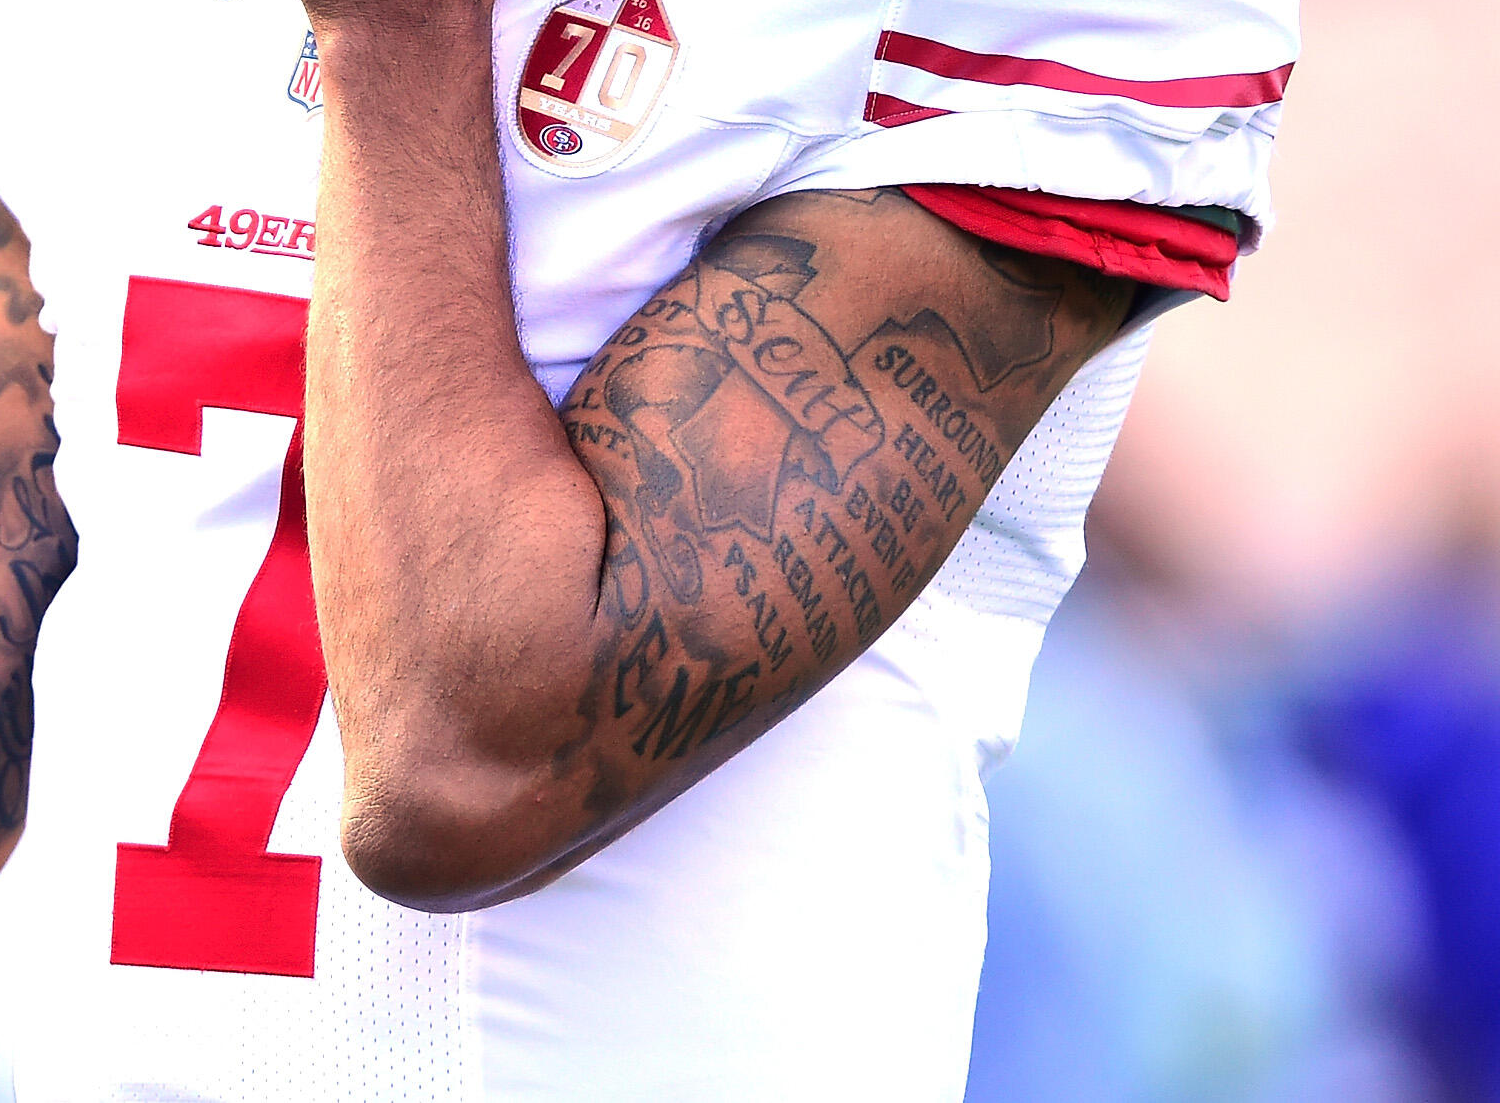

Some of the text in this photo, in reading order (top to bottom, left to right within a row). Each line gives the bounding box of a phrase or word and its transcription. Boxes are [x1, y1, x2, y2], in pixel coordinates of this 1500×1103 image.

[540, 23, 647, 111] 70
[634, 15, 654, 31] 16
[891, 478, 925, 533] BE
[893, 423, 967, 522] HEART
[846, 482, 904, 569] EVEN
[110, 274, 327, 980] 7
[724, 542, 793, 672] PSALM
[772, 532, 837, 664] REMAIN
